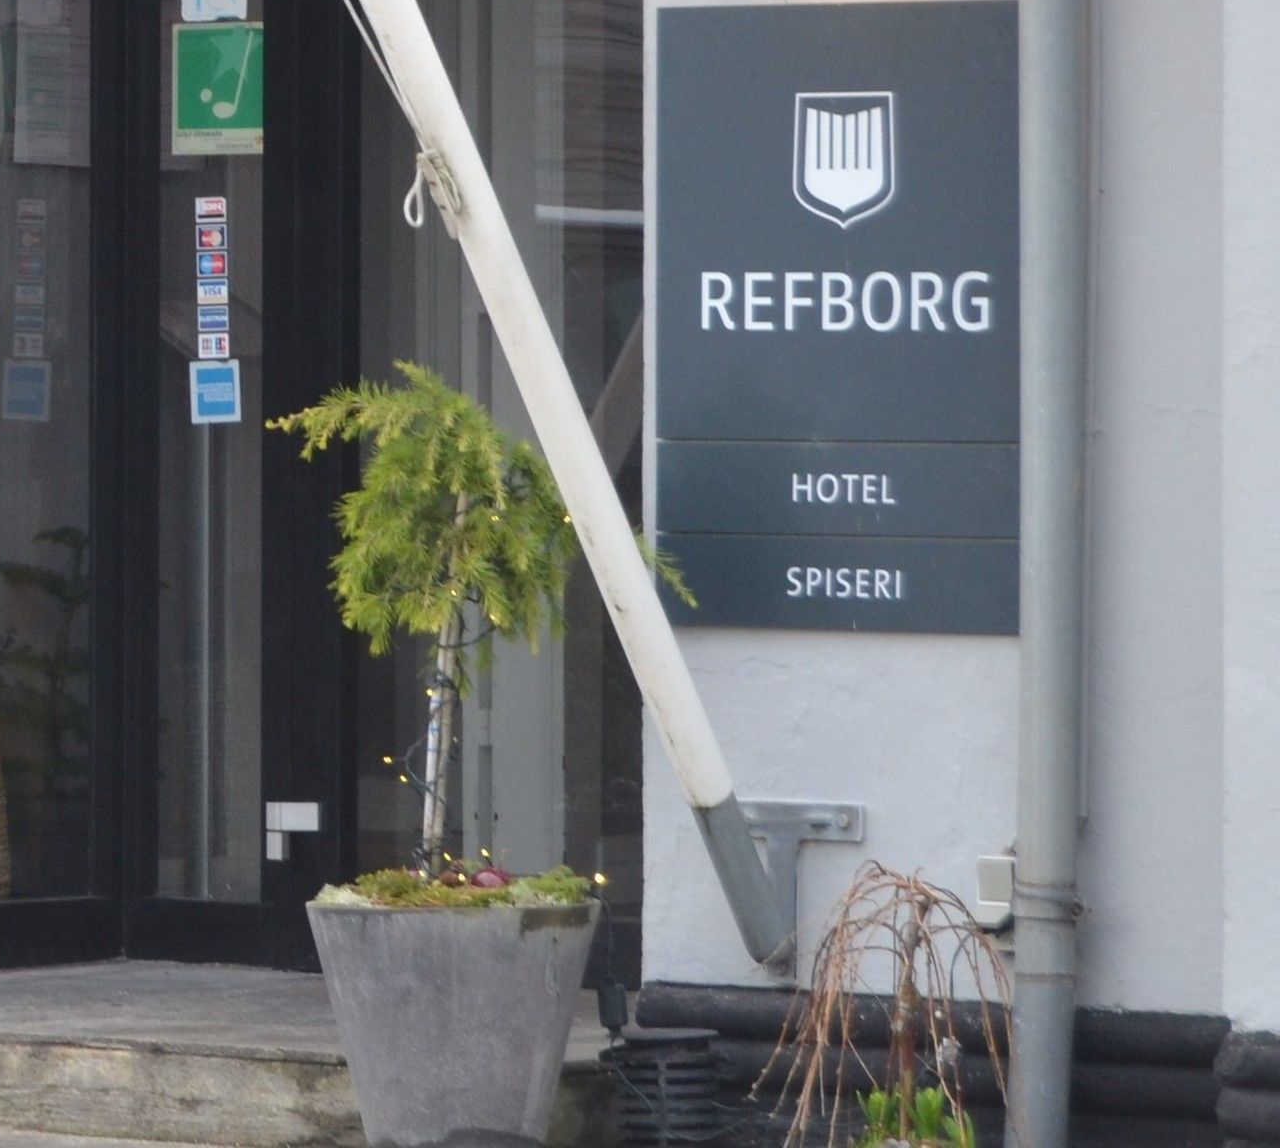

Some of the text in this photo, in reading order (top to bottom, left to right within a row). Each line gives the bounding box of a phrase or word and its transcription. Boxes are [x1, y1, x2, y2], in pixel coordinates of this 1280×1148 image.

[202, 286, 223, 296] VISA
[700, 271, 992, 331] REFBORG
[792, 473, 895, 504] HOTEL
[786, 567, 902, 600] SPISERI
